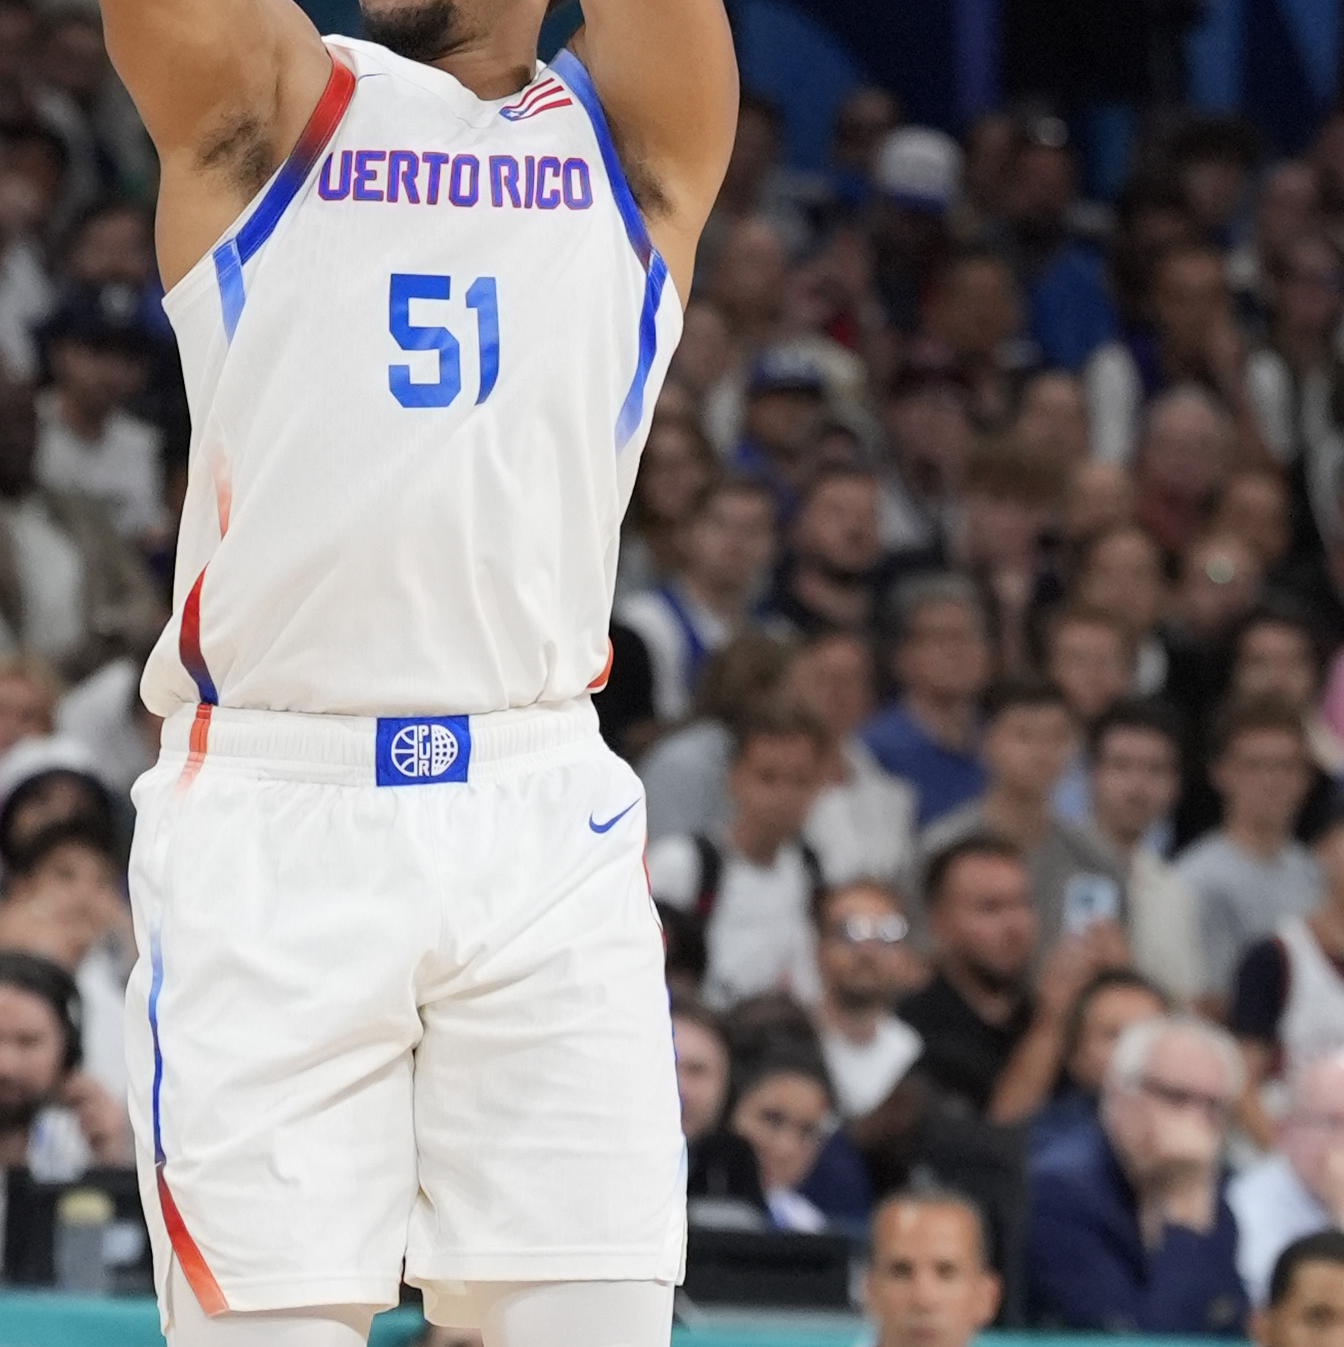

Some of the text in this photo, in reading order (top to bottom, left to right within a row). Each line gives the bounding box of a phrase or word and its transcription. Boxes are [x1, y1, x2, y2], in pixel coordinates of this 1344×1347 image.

[317, 150, 594, 210] UERTO RICO
[388, 272, 500, 408] 51
